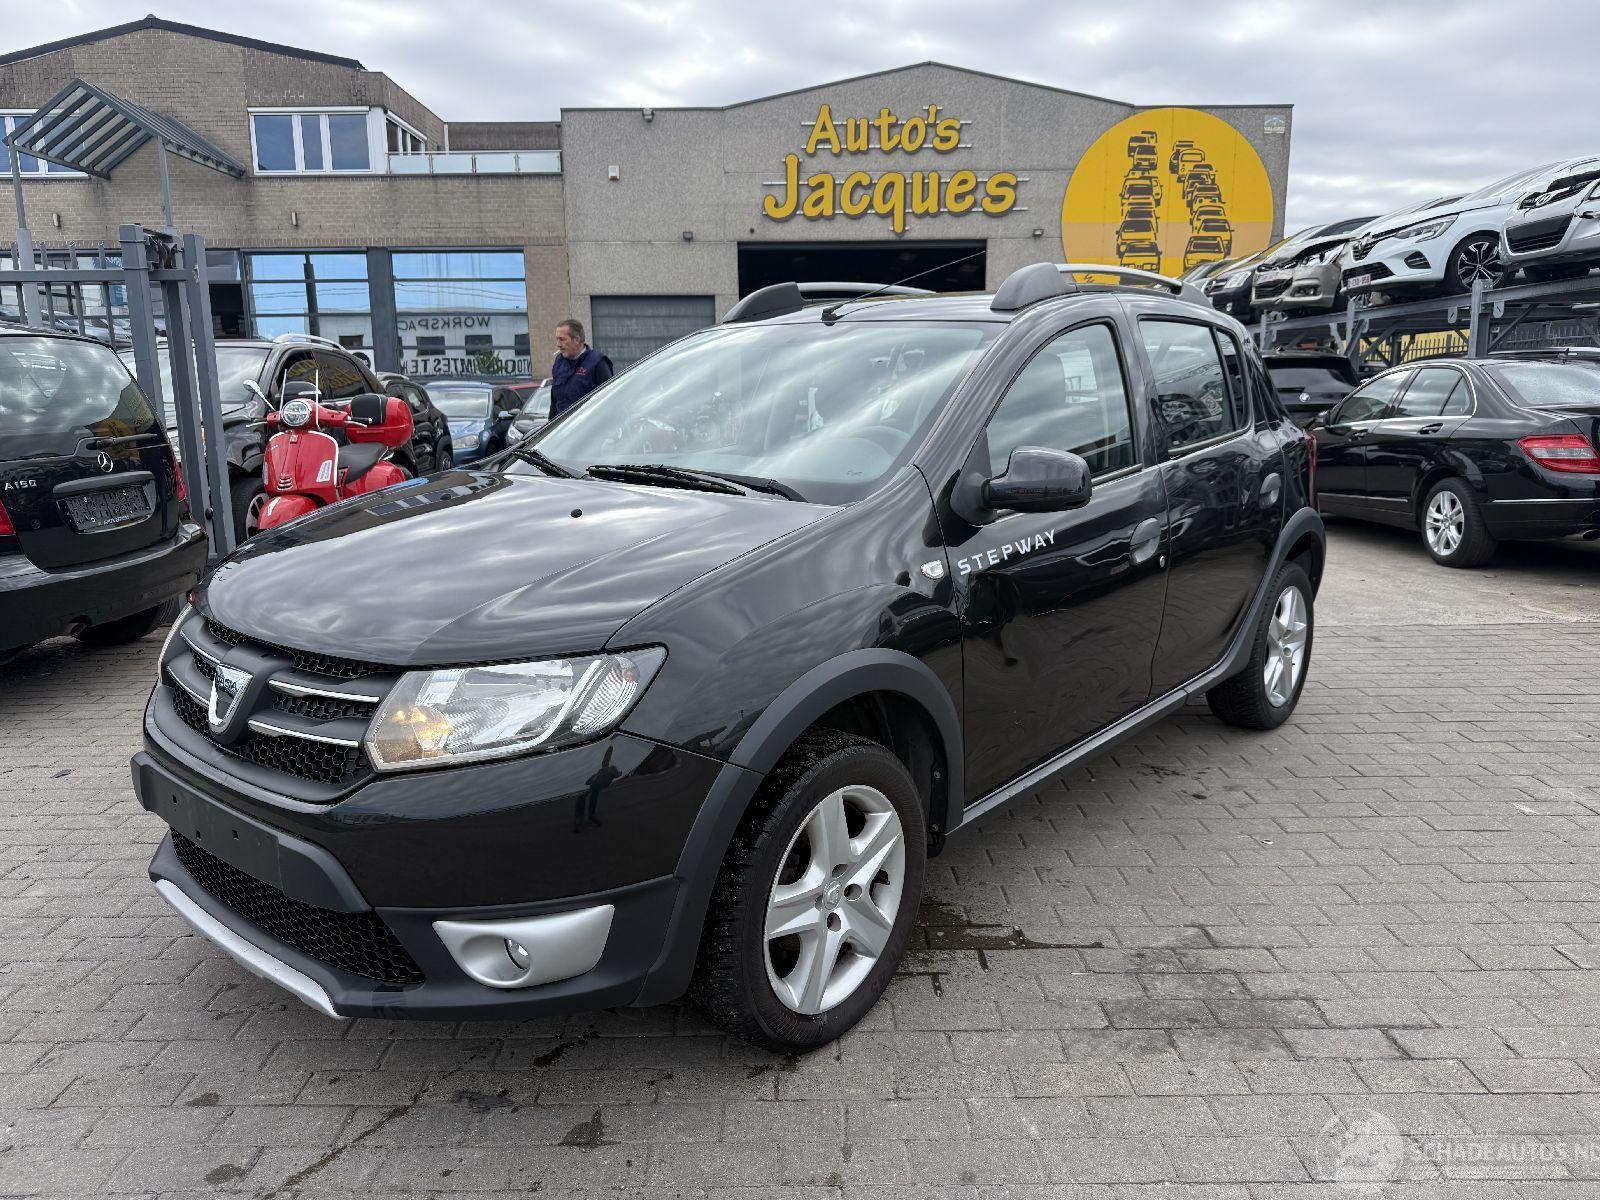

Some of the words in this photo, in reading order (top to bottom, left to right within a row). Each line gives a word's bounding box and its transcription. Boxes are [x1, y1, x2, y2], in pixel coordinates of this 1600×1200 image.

[804, 104, 962, 155] Auto's
[763, 153, 1018, 235] Jacques
[957, 529, 1056, 576] STEPWAY
